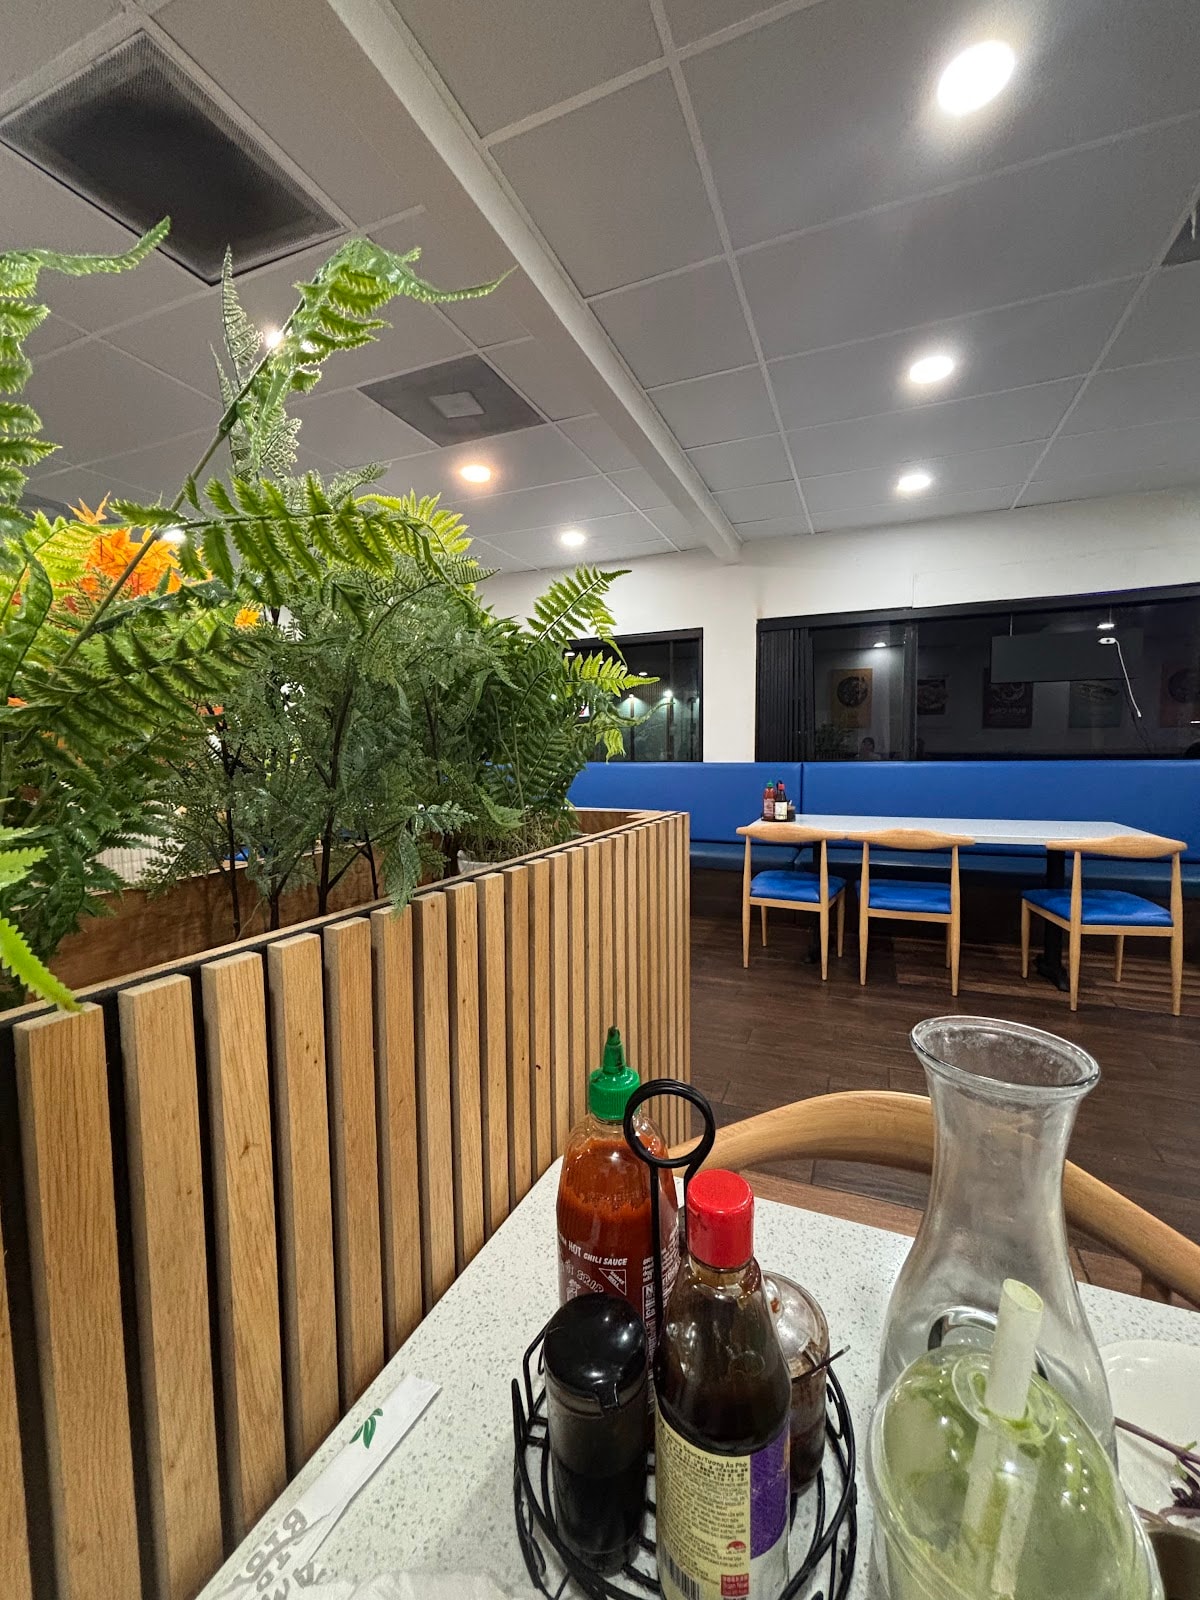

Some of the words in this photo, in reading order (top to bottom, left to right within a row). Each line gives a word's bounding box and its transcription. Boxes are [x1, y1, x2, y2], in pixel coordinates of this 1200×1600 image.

[568, 1240, 581, 1257] HOT
[583, 1252, 602, 1264] CHILI
[603, 1257, 628, 1266] SAUCE
